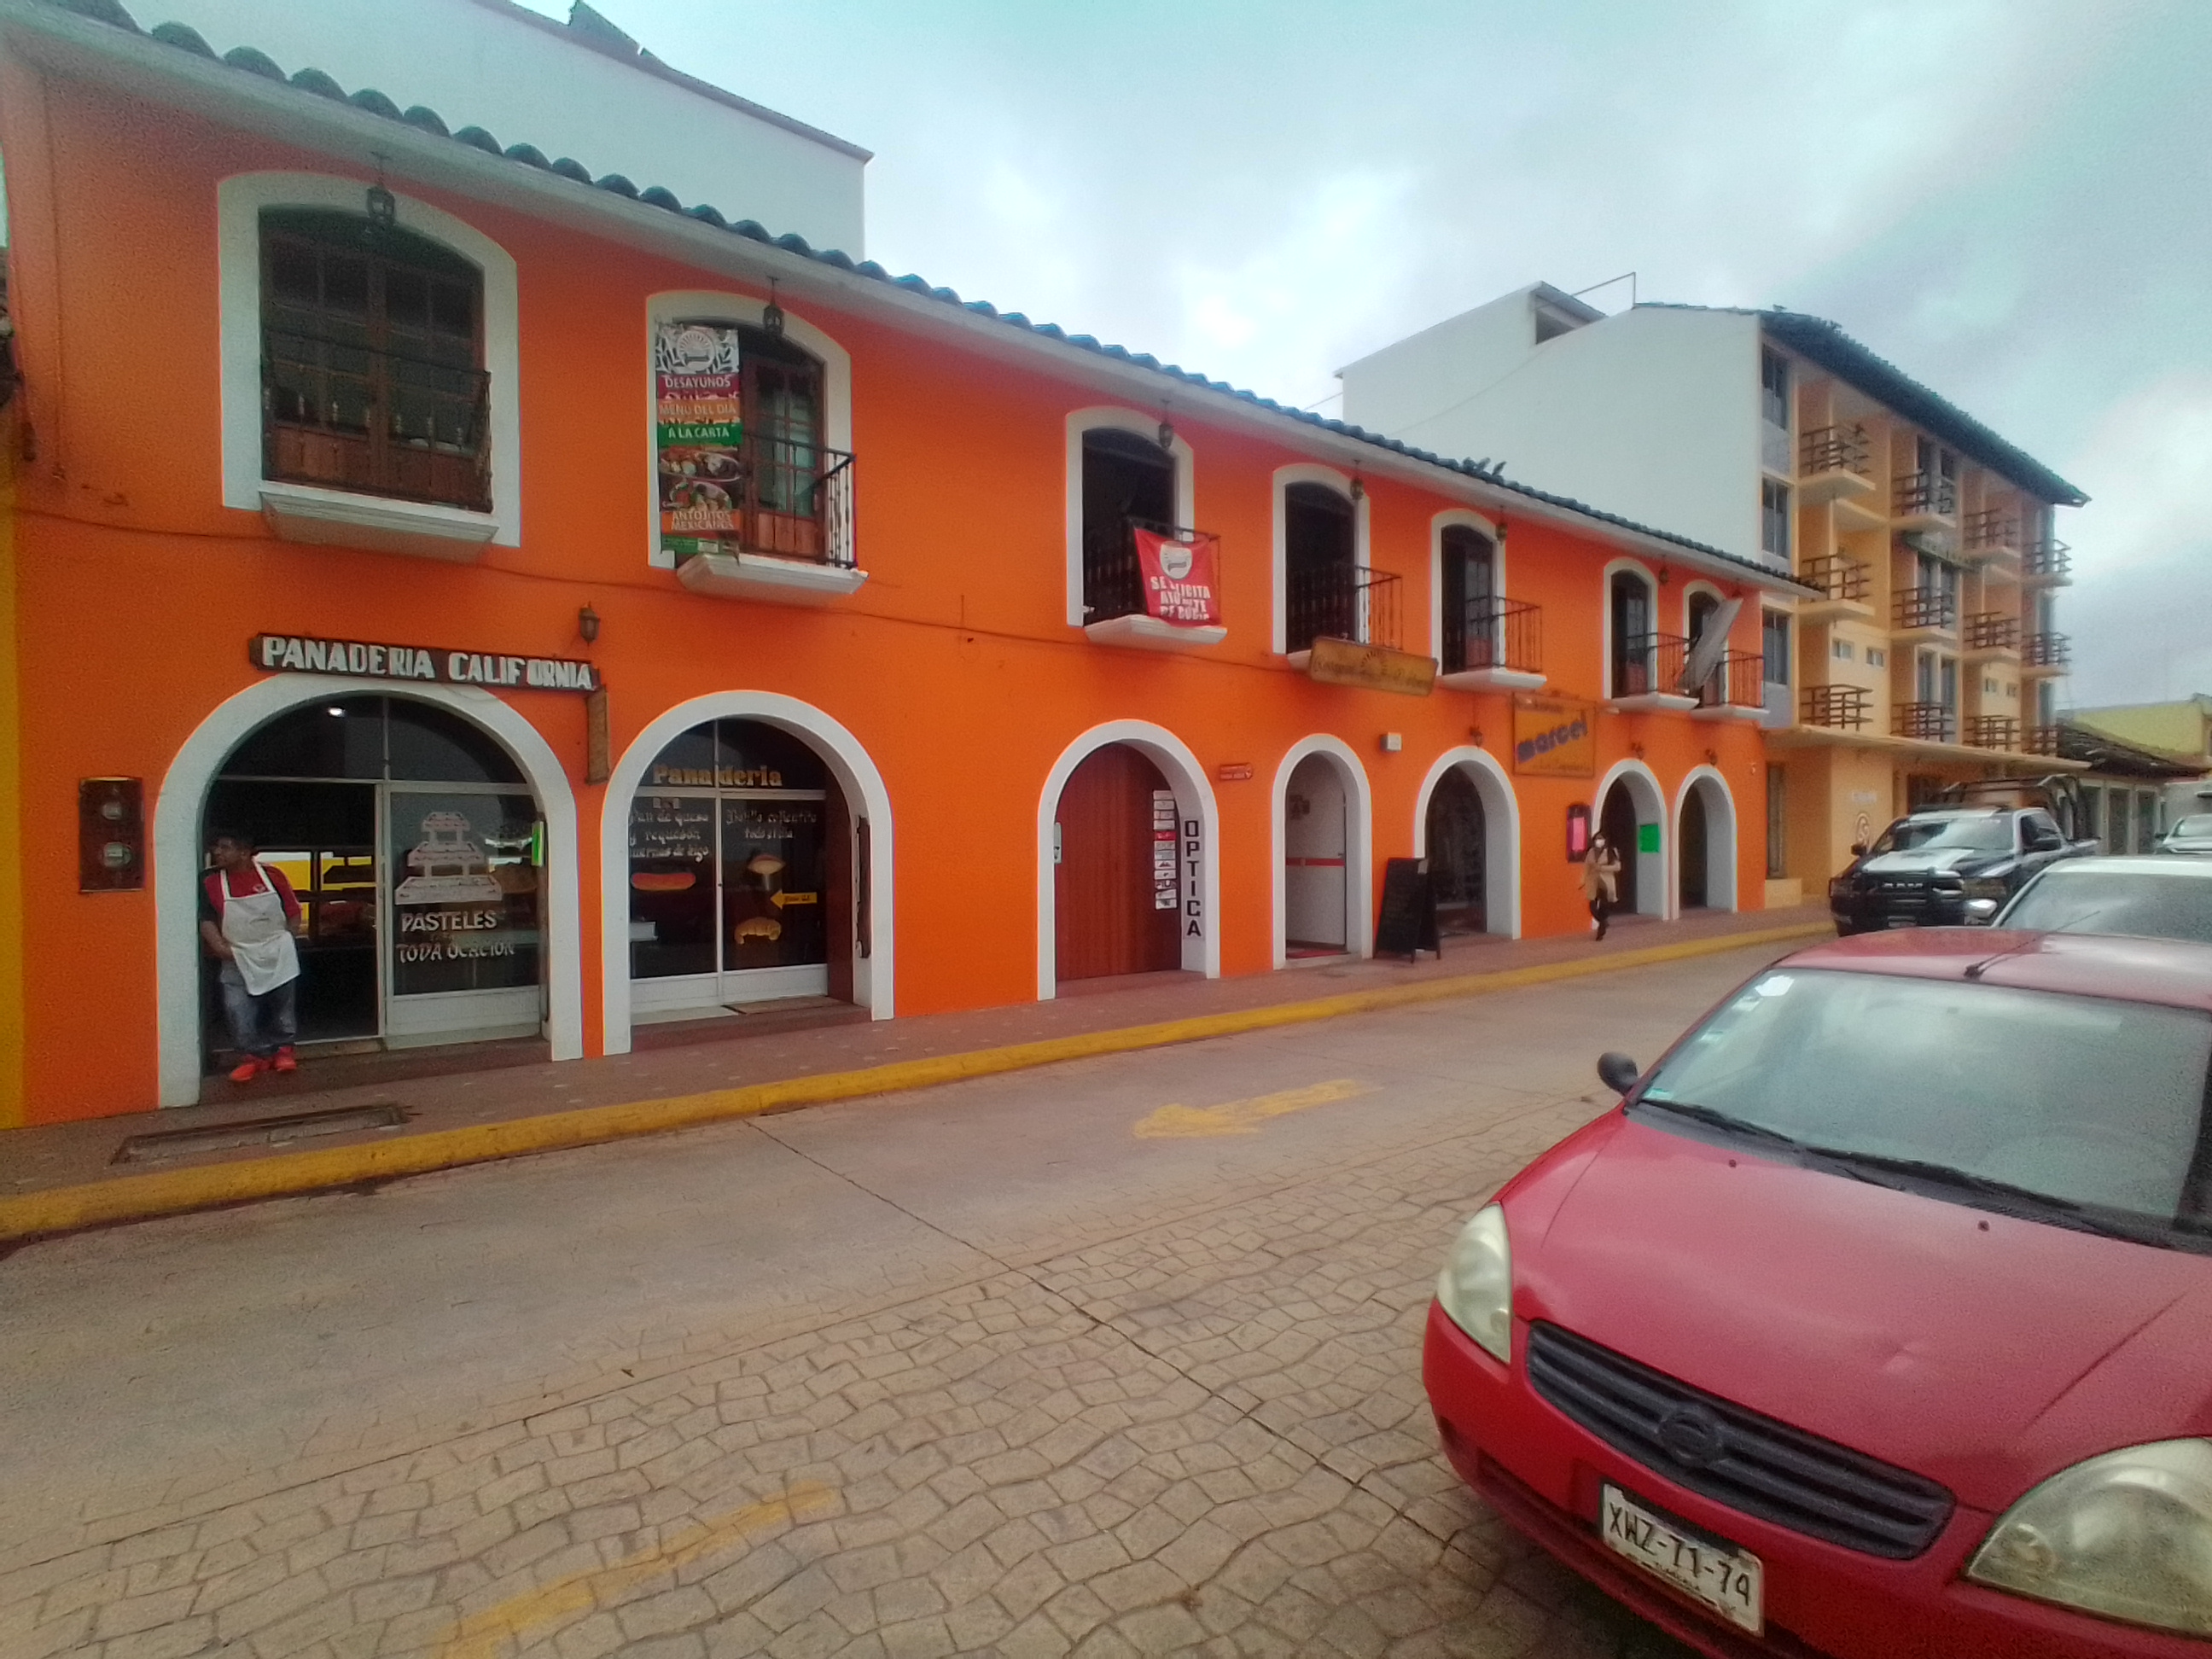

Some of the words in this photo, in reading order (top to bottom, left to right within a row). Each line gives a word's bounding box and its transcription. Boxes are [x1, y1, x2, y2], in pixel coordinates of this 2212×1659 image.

[665, 376, 731, 388] DESAYUNOS
[668, 427, 677, 439] A
[678, 428, 693, 439] LA
[694, 427, 730, 439] CARTA
[672, 509, 731, 521] ANTOJITOS
[1150, 575, 1167, 590] SE
[262, 636, 435, 678] PANADERIA
[448, 652, 597, 691] CALIFORNIA
[1185, 819, 1202, 937] OPTICA
[401, 910, 498, 932] PASTELES
[396, 941, 442, 963] TODA
